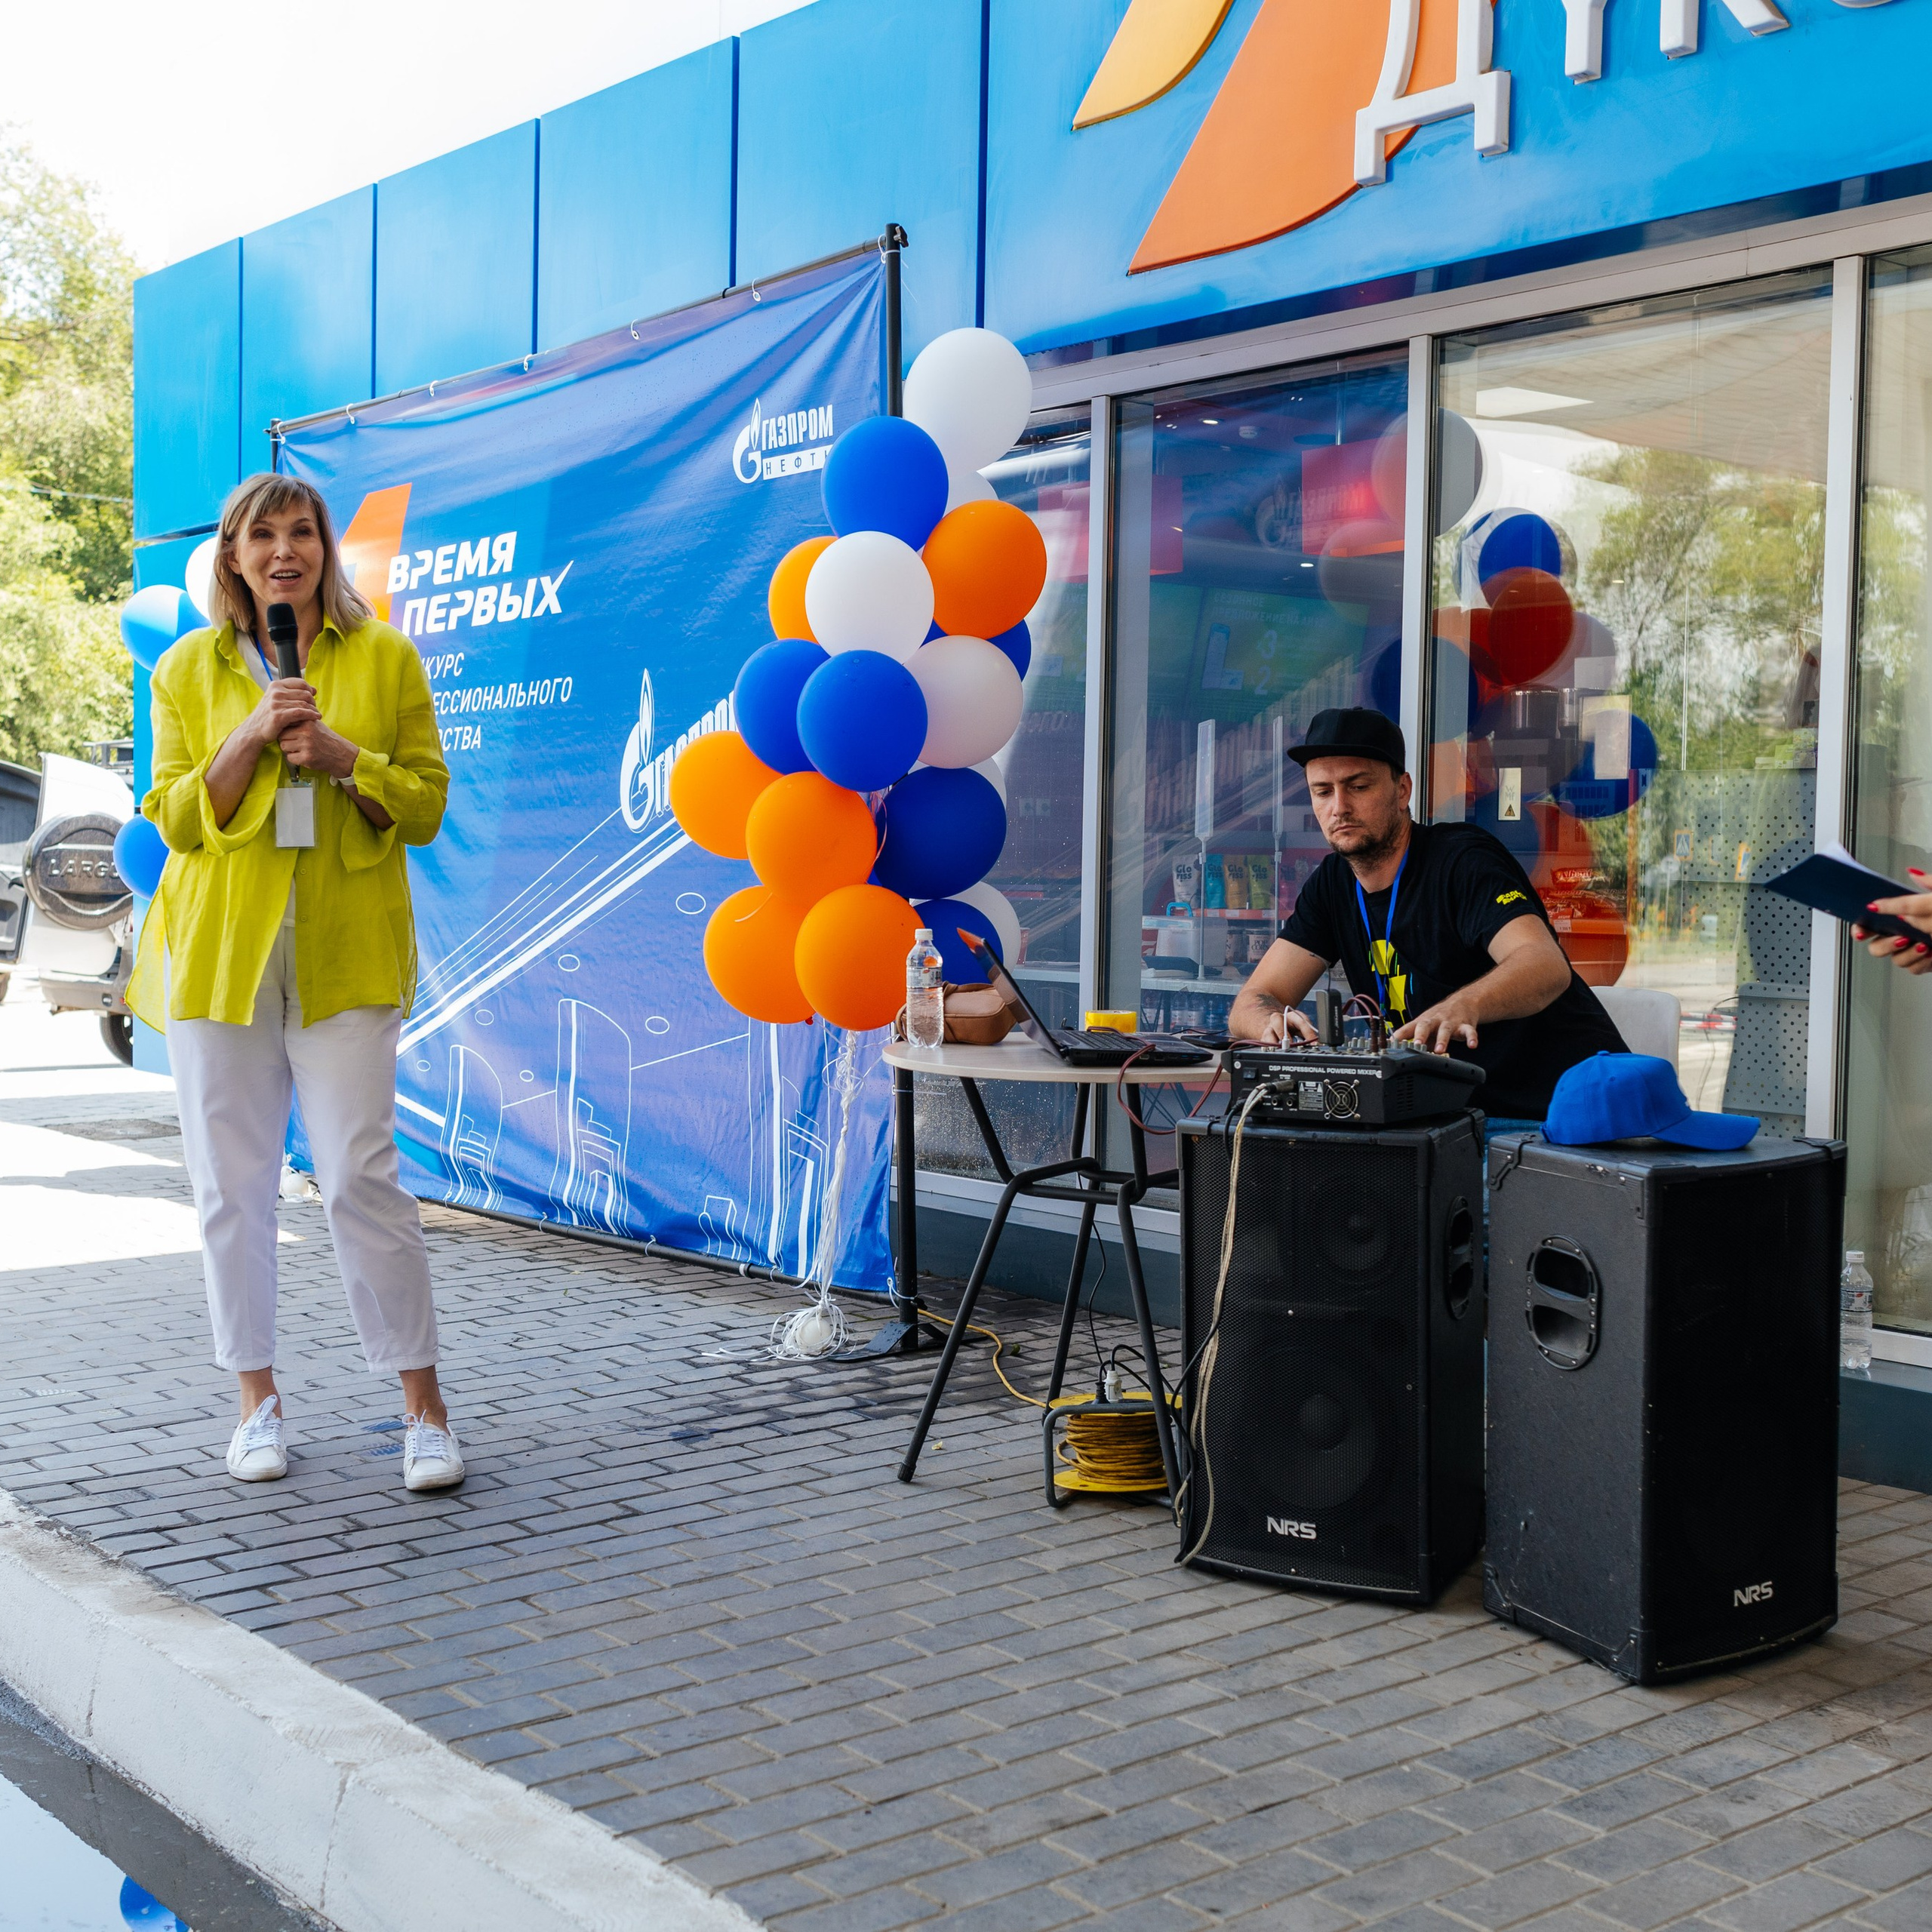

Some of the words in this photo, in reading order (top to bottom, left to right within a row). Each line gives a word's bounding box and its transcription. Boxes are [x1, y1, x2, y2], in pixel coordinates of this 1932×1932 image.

[761, 404, 833, 451] ГАЗПРОМ
[386, 531, 517, 595] ВРЕМЯ
[401, 560, 574, 637] ПЕРВЫХ
[422, 652, 465, 680] КУРС
[1176, 864, 1192, 872] Glo
[1228, 864, 1244, 872] Glo
[1252, 864, 1268, 872] Glo
[1267, 1515, 1317, 1540] NRS
[1734, 1580, 1774, 1607] NRS
